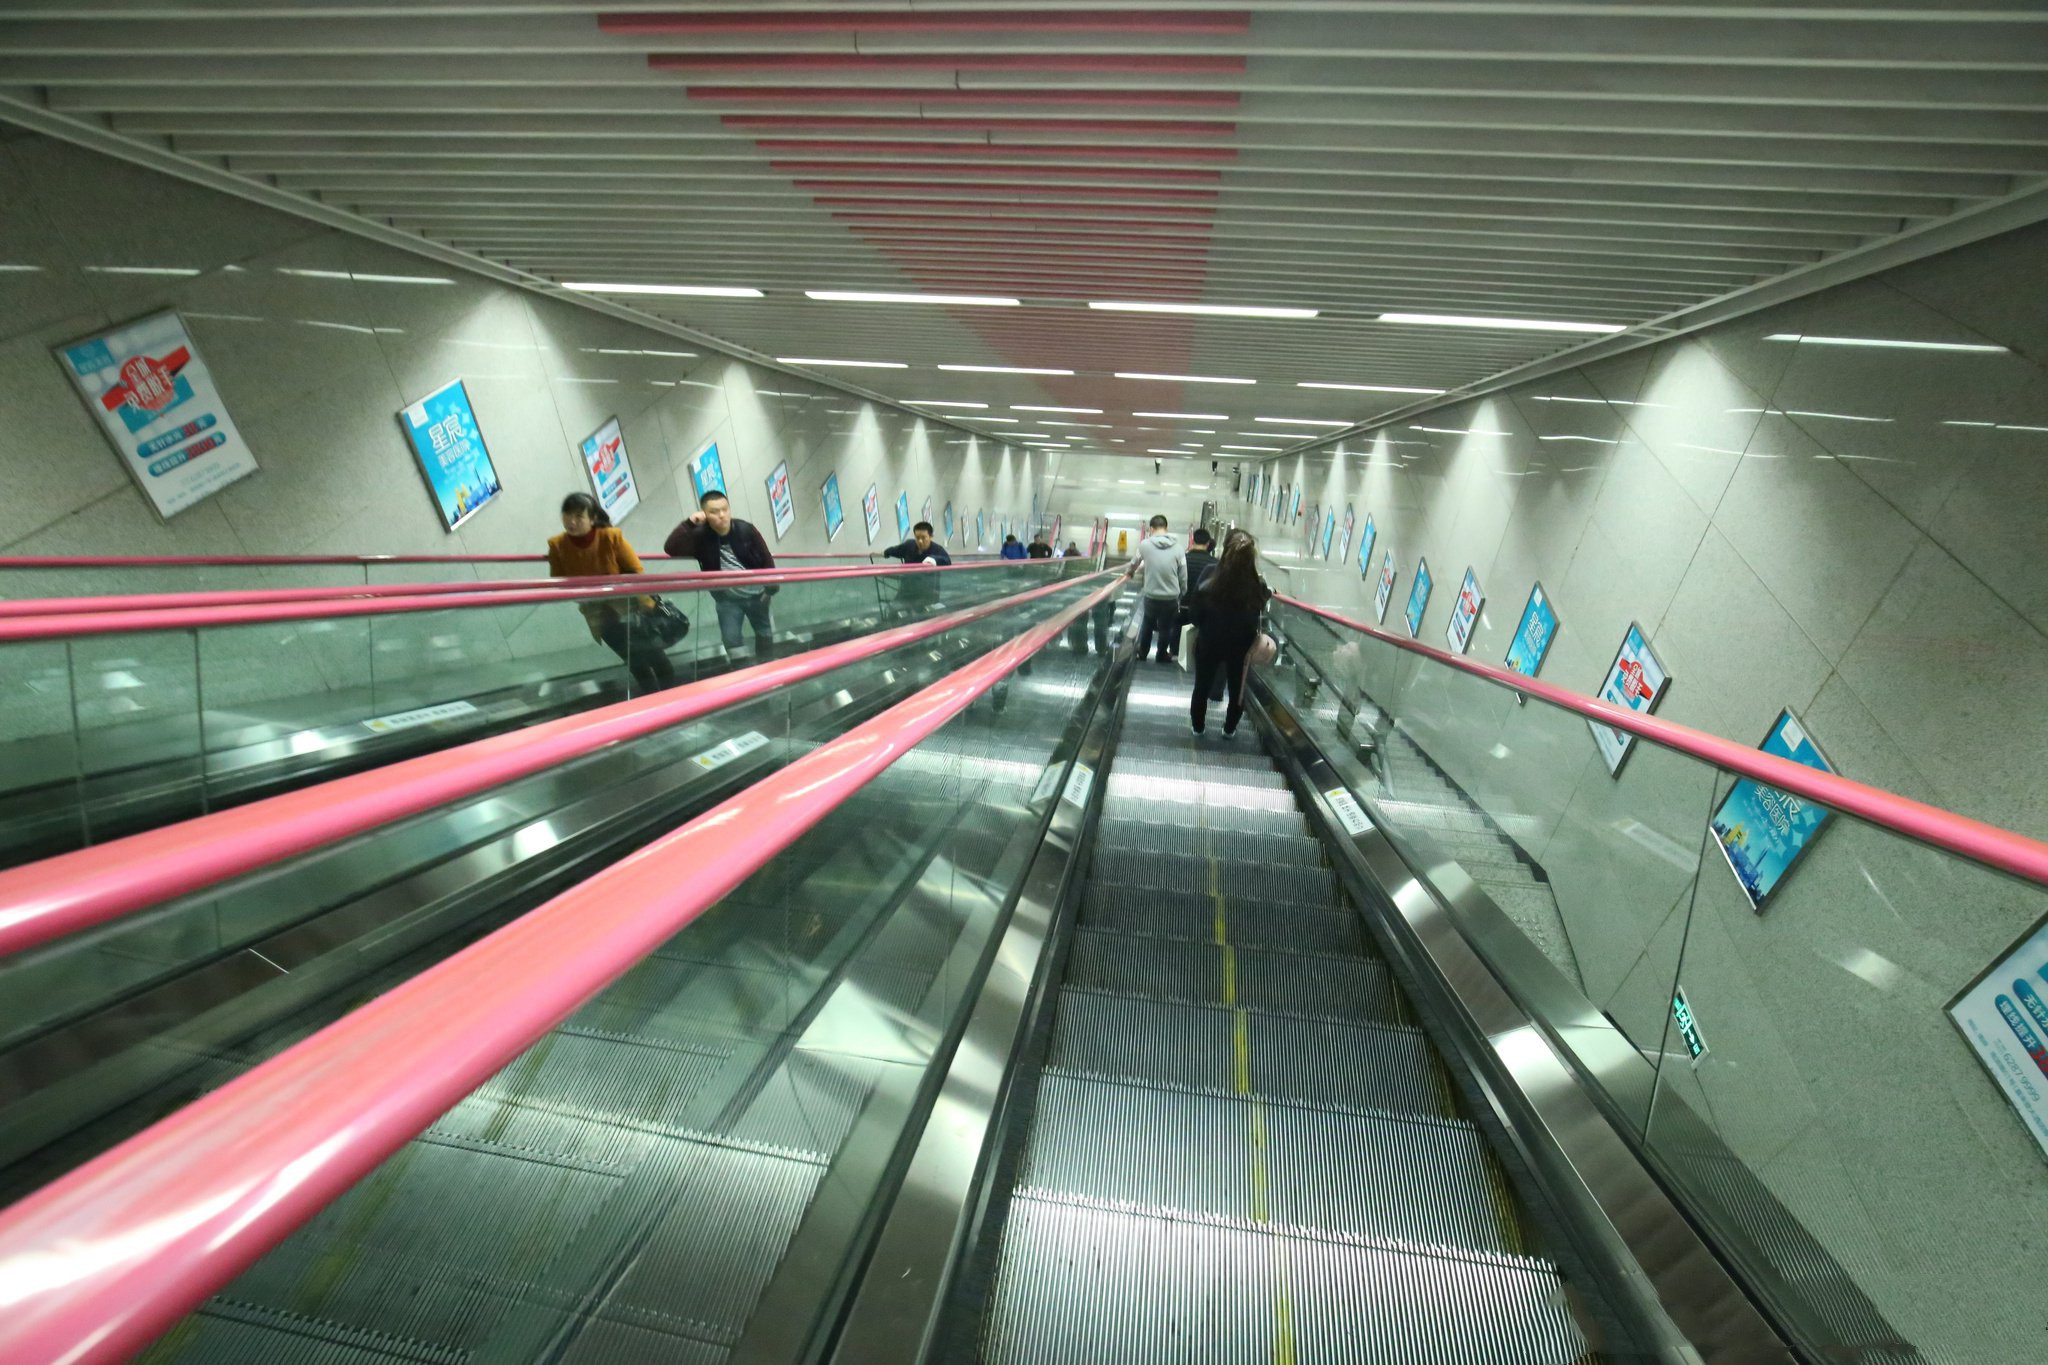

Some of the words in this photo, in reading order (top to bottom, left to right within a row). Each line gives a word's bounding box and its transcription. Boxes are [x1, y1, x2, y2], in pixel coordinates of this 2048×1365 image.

[429, 415, 466, 454] 星宸
[1754, 785, 1790, 836] 美容医院
